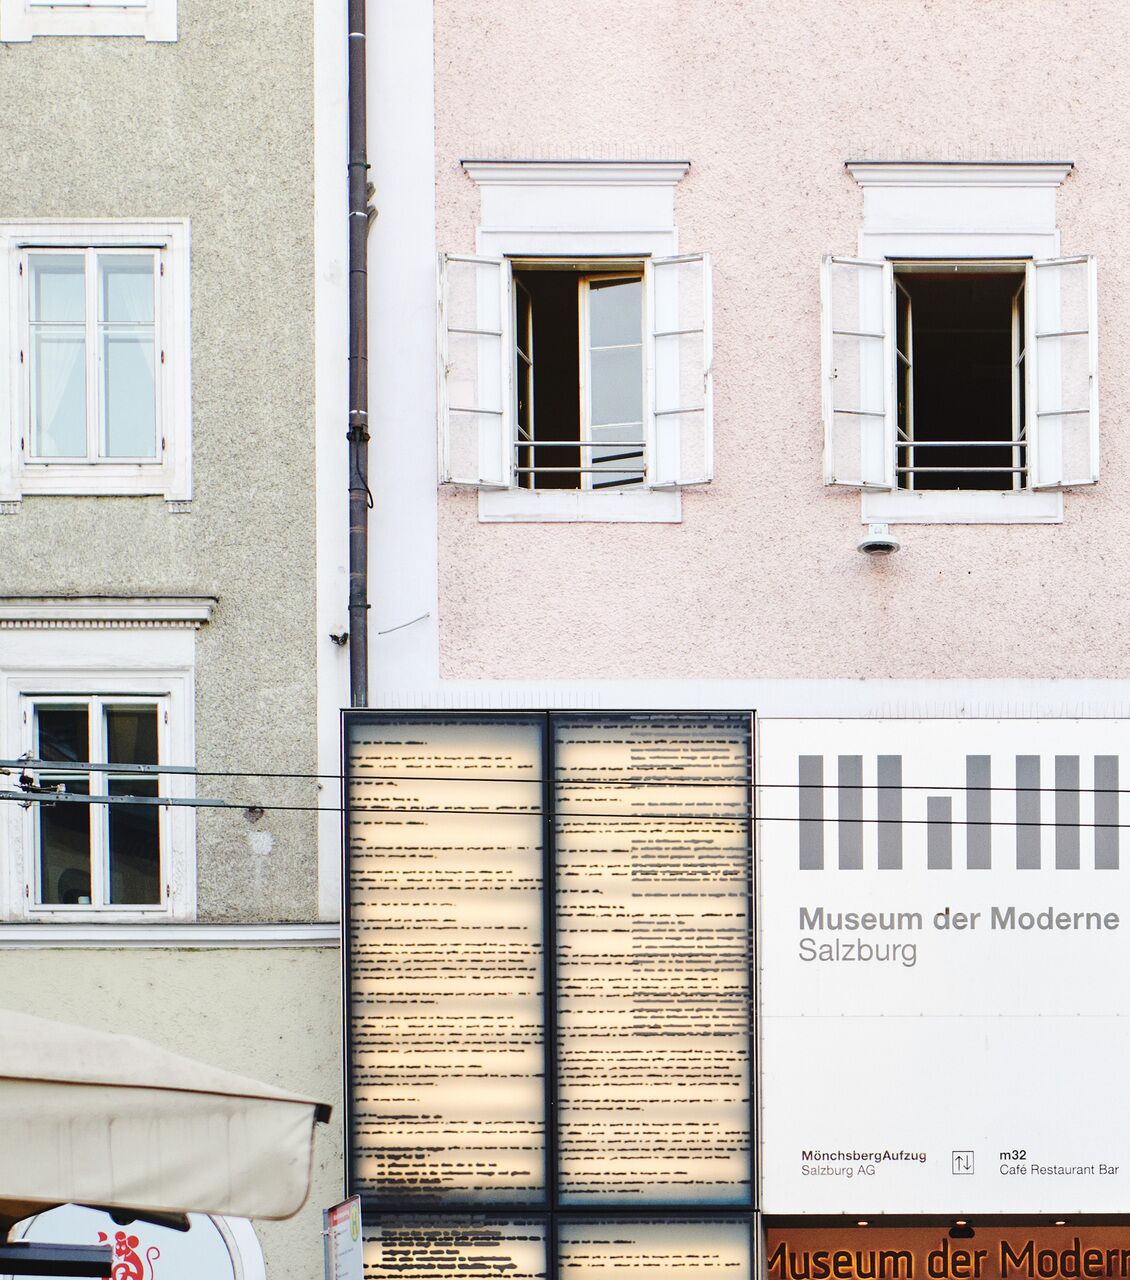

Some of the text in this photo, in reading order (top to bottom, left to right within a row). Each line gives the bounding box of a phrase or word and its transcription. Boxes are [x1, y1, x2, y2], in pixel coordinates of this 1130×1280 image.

[799, 907, 1120, 931] Museum der Moderne
[798, 937, 917, 968] Salzburg
[801, 1149, 927, 1164] MönchsbergAufzug
[999, 1150, 1027, 1161] m32
[801, 1164, 876, 1178] Salzburg AG
[999, 1163, 1120, 1176] Café Restaurant Bar
[927, 1238, 988, 1280] der
